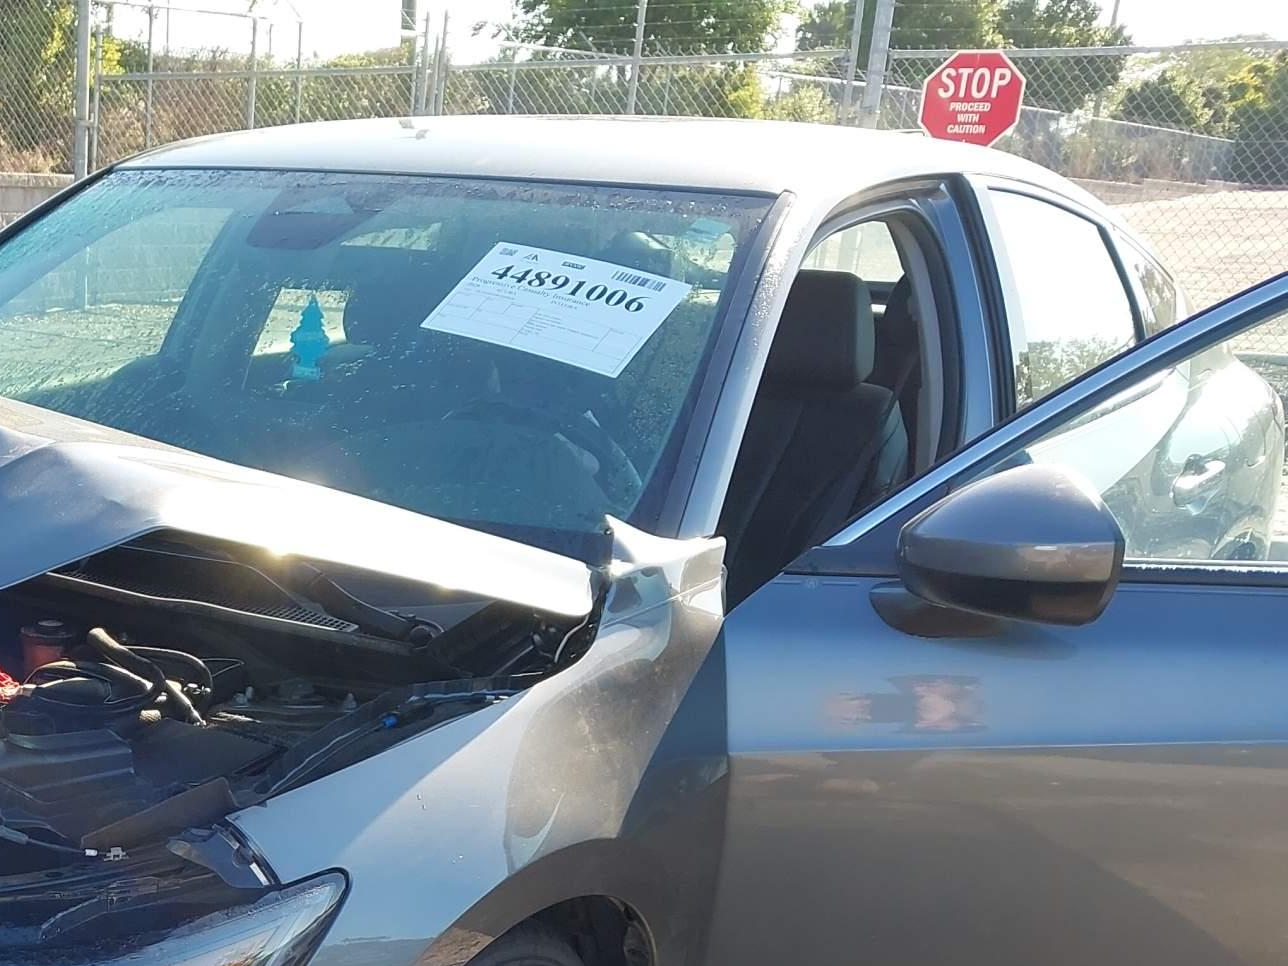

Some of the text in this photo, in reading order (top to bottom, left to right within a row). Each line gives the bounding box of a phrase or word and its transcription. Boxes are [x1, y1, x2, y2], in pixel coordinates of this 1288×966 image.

[937, 67, 1012, 99] STOP
[949, 102, 992, 112] PROCEED
[956, 113, 980, 123] WITH
[947, 124, 986, 134] CAUTION
[472, 276, 517, 290] Progressive
[517, 284, 550, 298] Casualty
[552, 293, 591, 307] Insurance
[490, 264, 652, 313] 44891006
